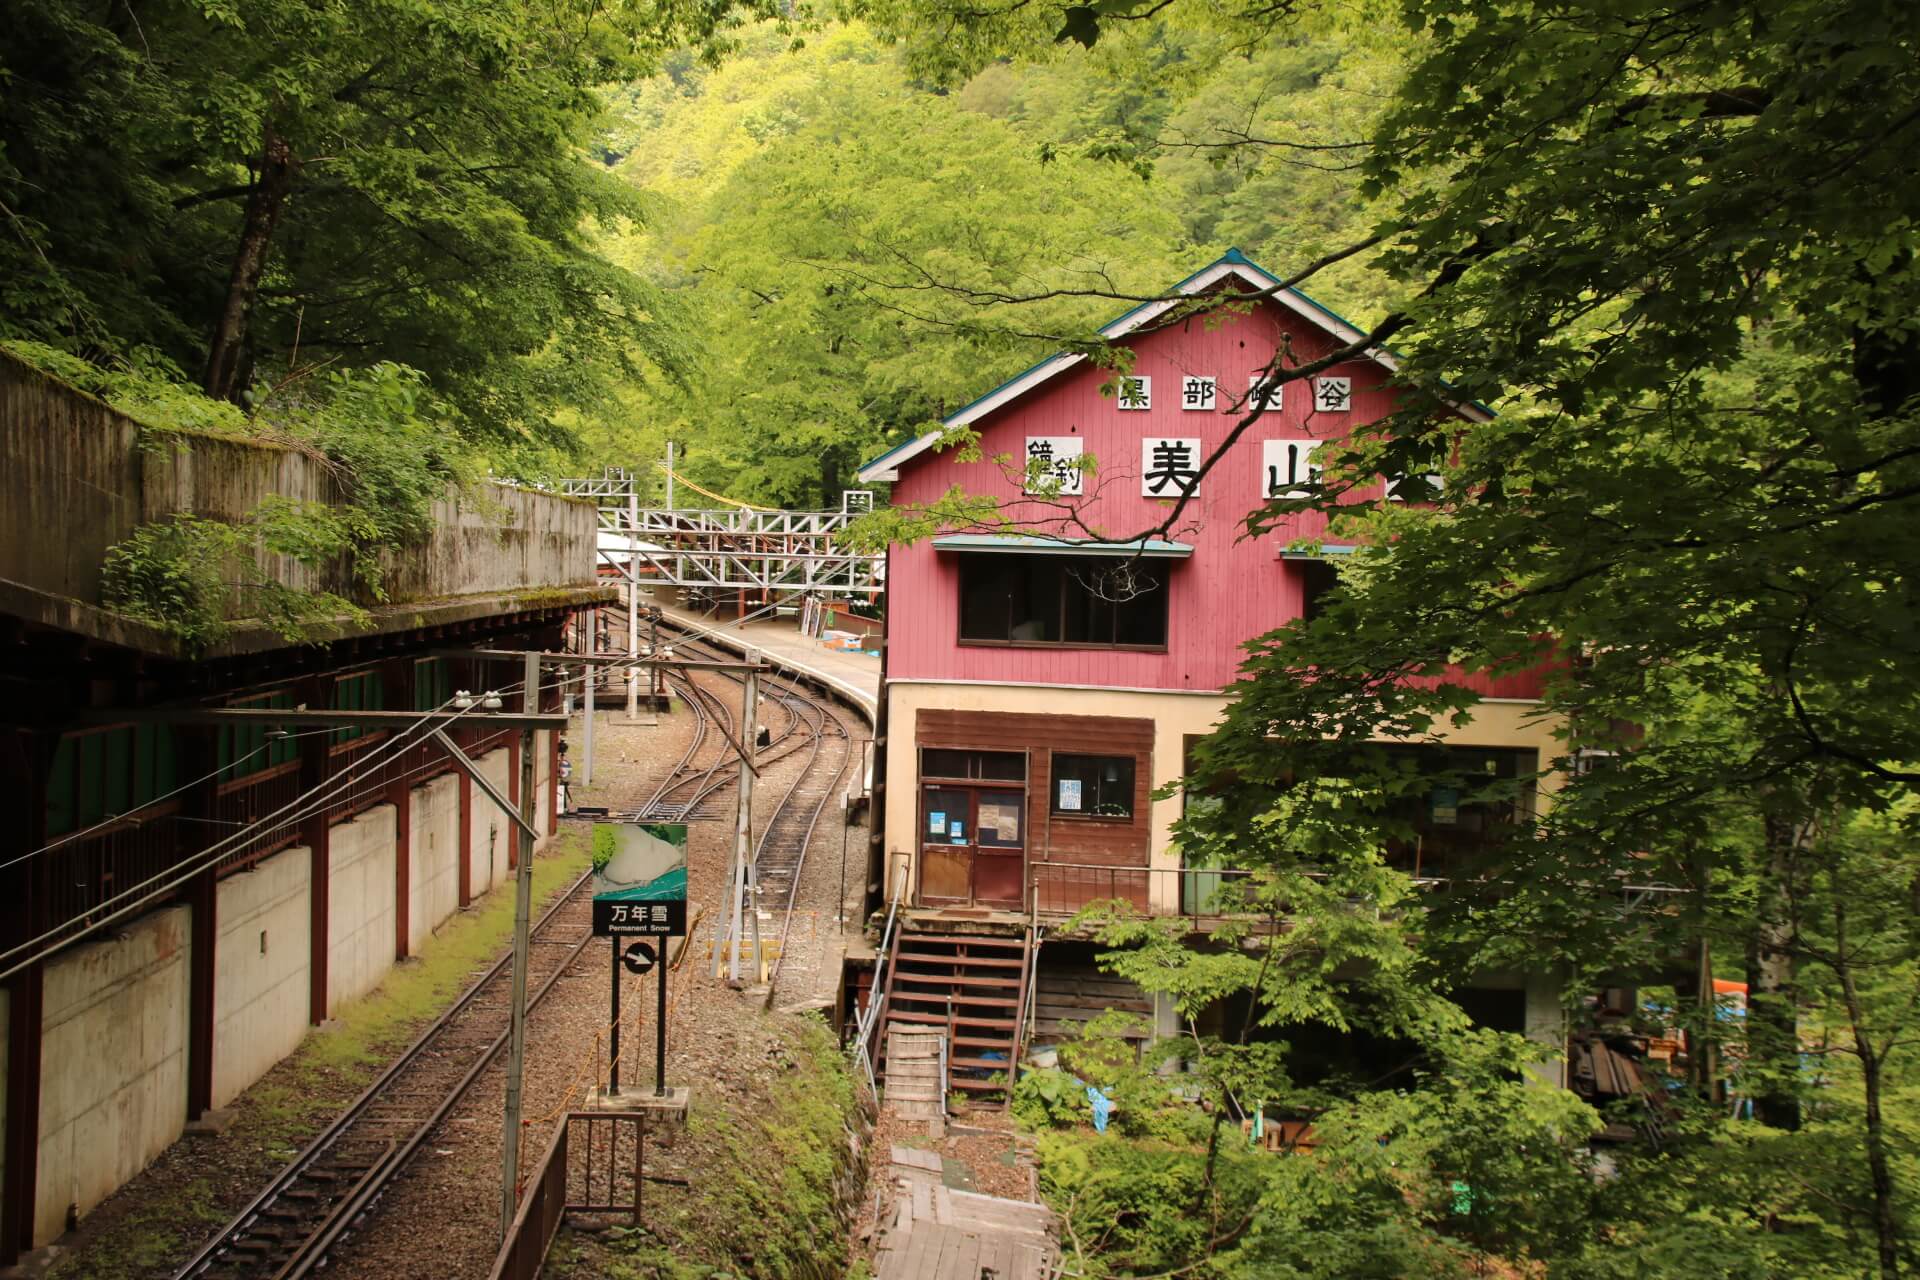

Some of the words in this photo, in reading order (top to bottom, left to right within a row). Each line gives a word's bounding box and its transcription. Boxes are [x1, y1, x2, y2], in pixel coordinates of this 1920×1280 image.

[611, 905, 667, 922] 万年雪
[608, 924, 647, 932] Permanent
[650, 924, 671, 932] Snow
